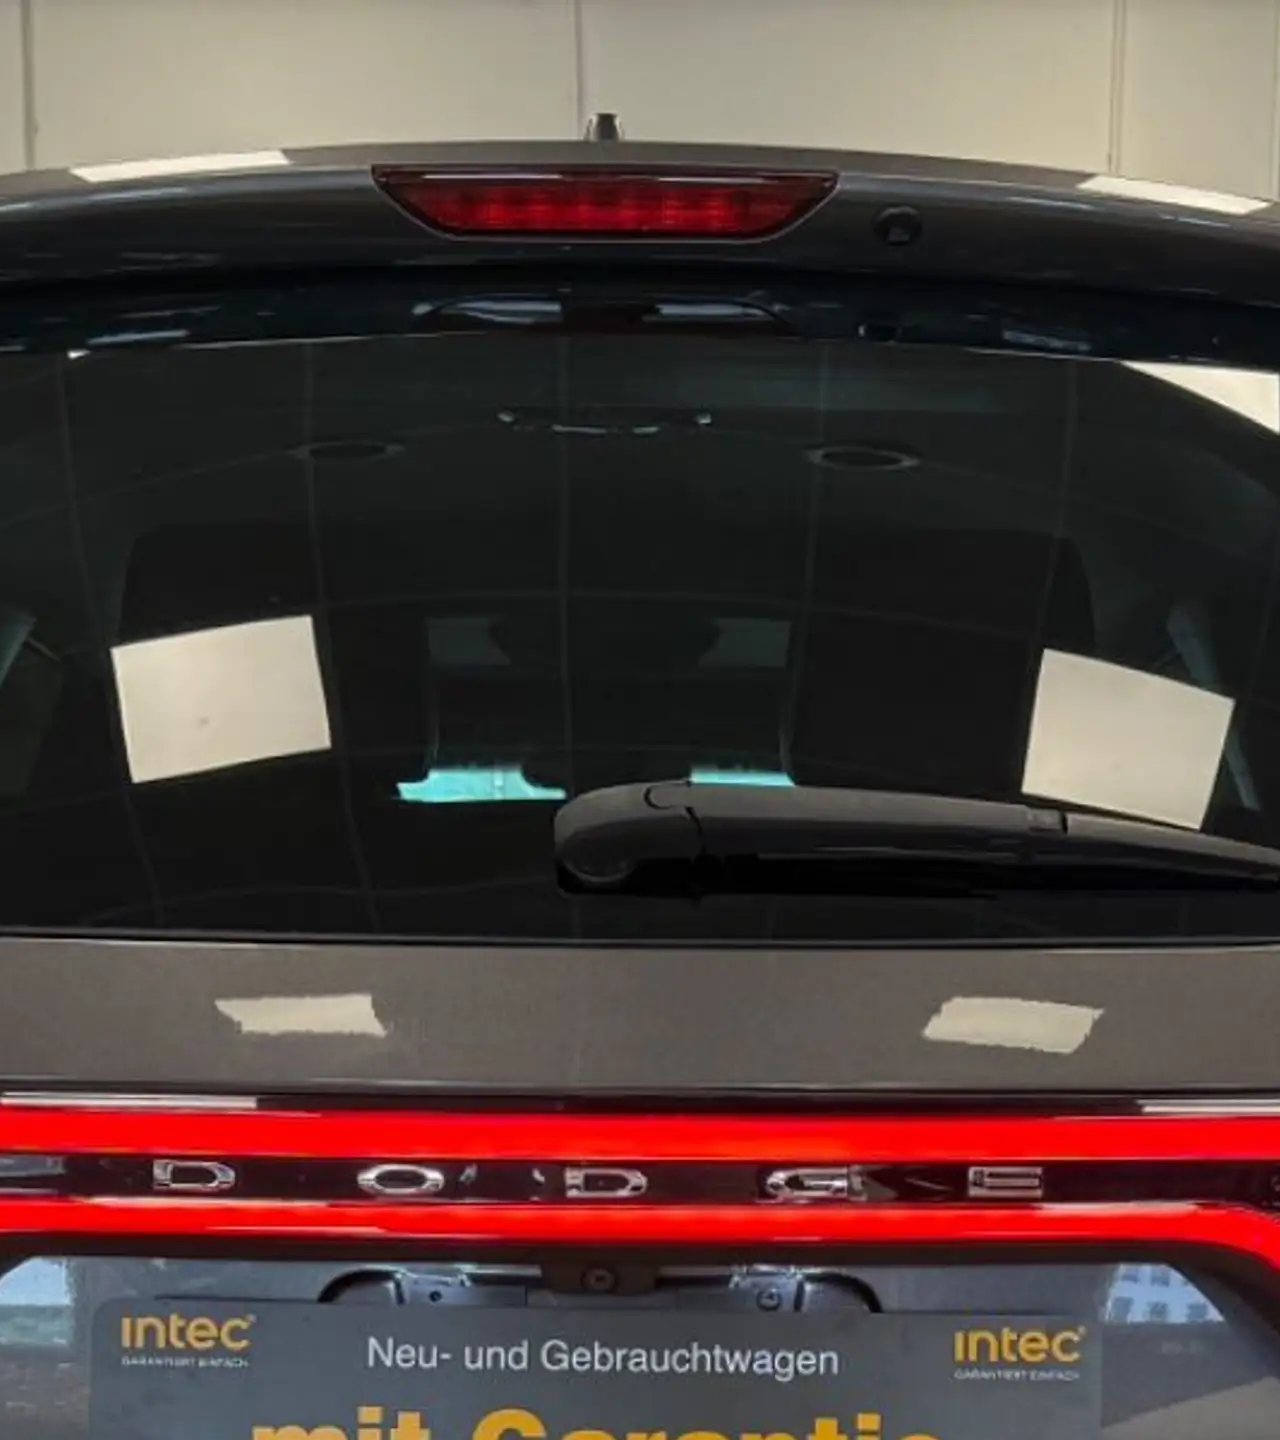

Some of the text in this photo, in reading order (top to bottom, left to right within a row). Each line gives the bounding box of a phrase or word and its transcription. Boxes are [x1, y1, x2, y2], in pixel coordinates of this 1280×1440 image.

[151, 1158, 1044, 1198] DODGE
[121, 1313, 255, 1349] intec
[954, 1326, 1086, 1362] intec
[367, 1336, 839, 1382] Neu- und Gebrauchtwagen
